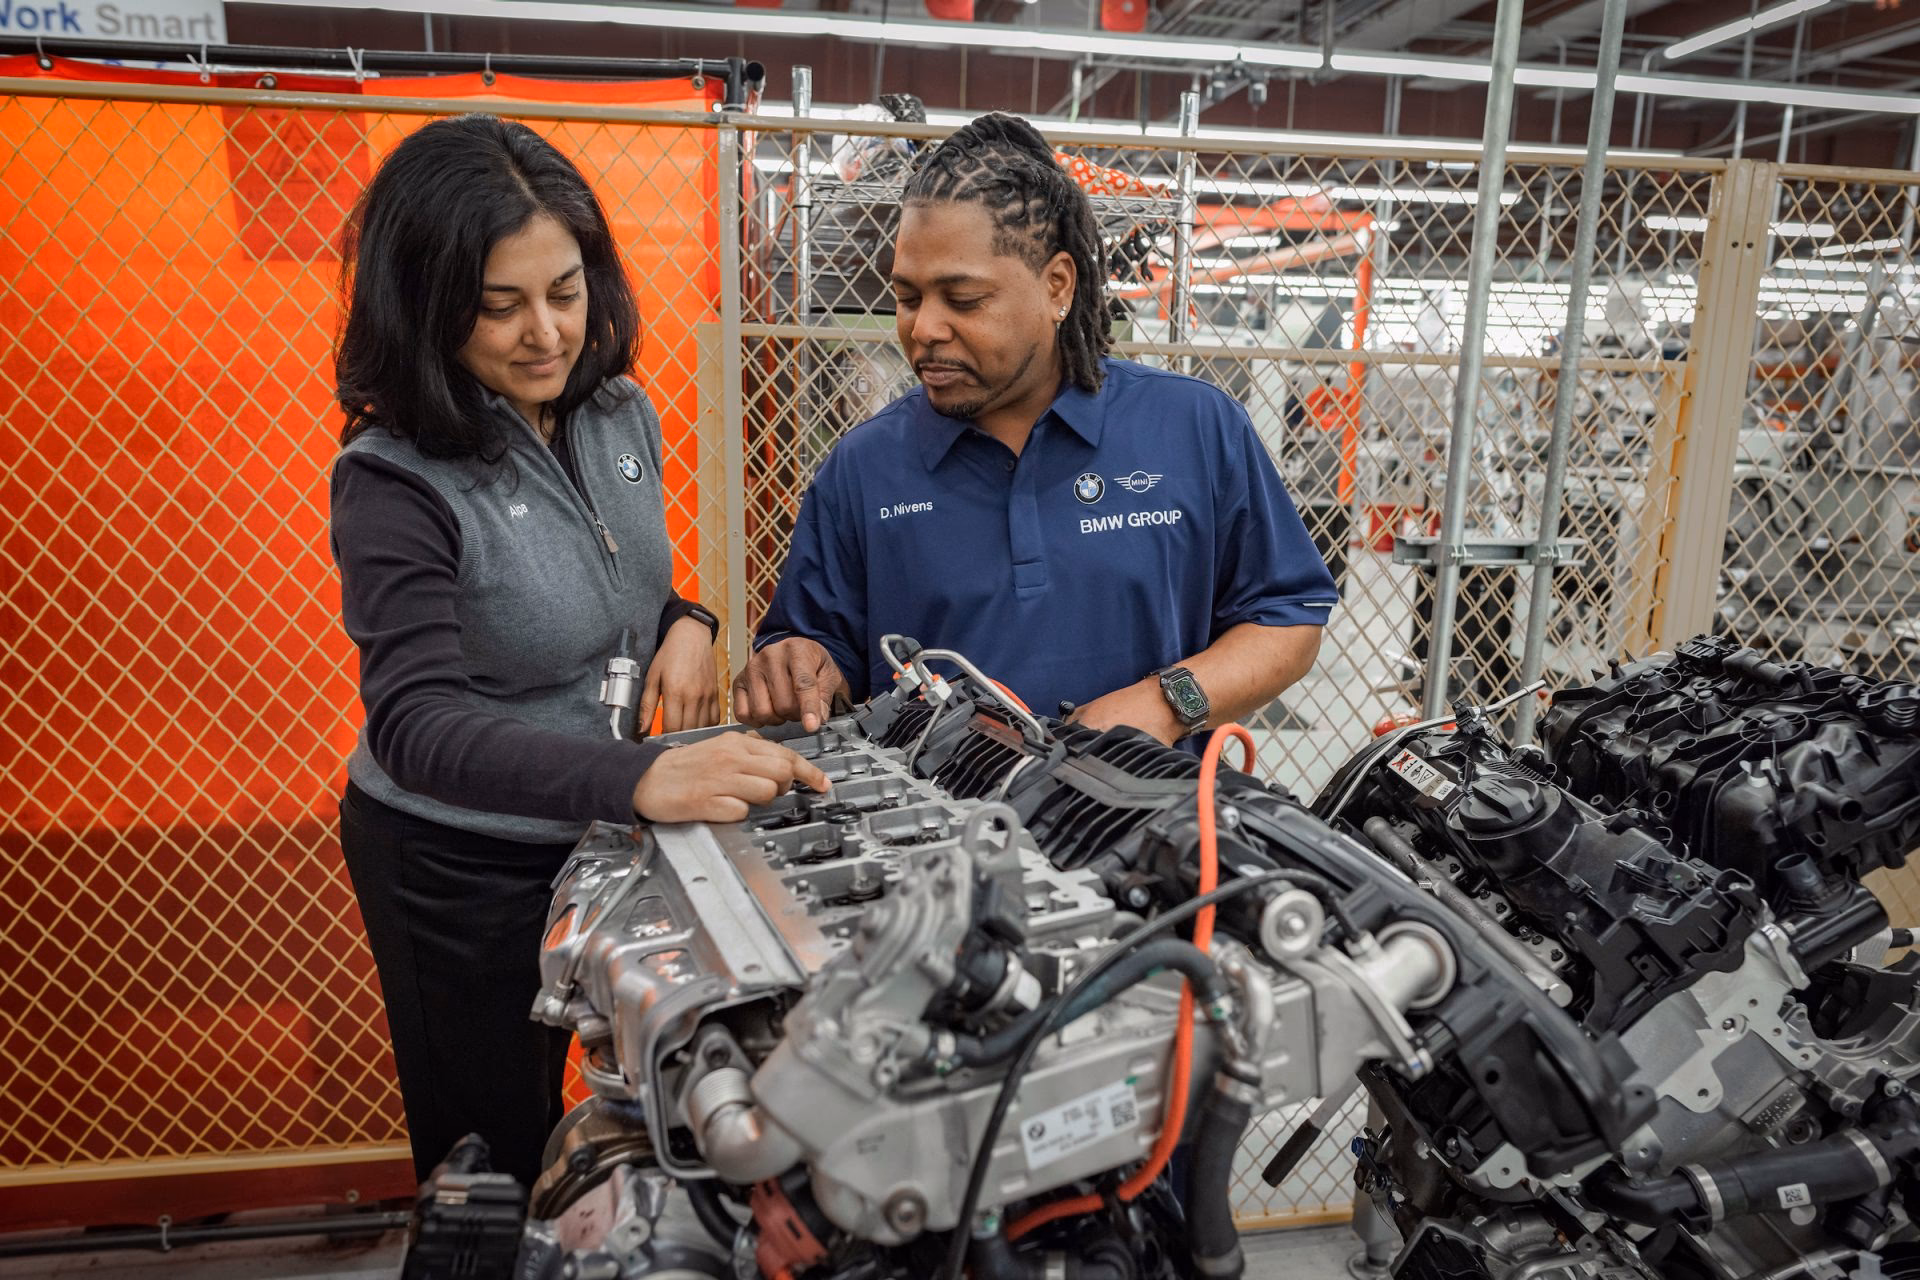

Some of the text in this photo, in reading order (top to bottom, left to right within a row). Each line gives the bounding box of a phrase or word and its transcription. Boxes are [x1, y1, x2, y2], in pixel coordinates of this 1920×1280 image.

[96, 4, 216, 40] Smart
[1131, 478, 1148, 486] MINI
[509, 503, 528, 518] Alpa
[1080, 510, 1182, 534] BMW GROUP
